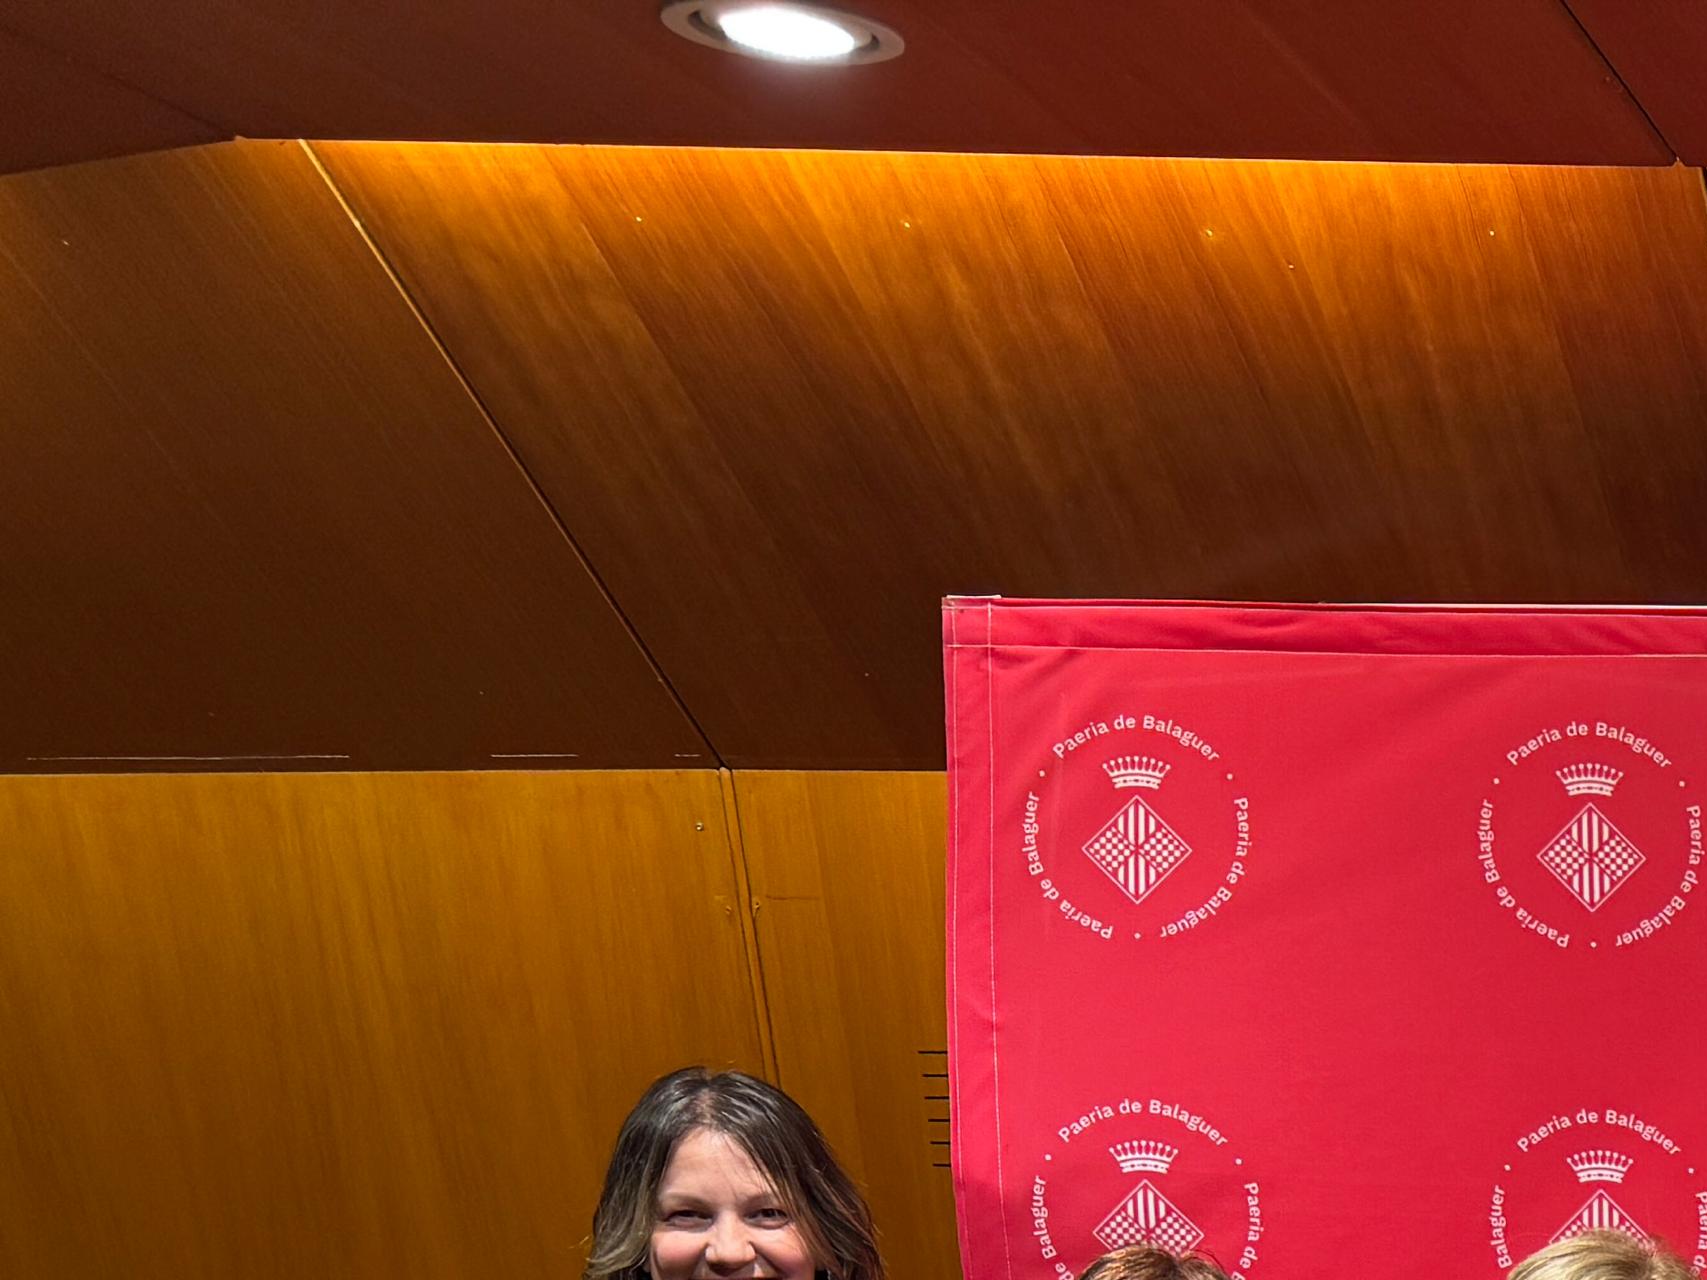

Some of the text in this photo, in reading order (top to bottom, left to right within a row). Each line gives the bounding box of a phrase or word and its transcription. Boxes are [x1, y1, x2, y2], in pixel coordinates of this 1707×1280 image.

[1053, 715, 1219, 760] Paeria de Balaguer
[1507, 721, 1671, 767] Paeria de Balaguer
[1058, 1099, 1228, 1145] Paeria de Balaguer
[1517, 1109, 1681, 1154] Paeria de Balaguer
